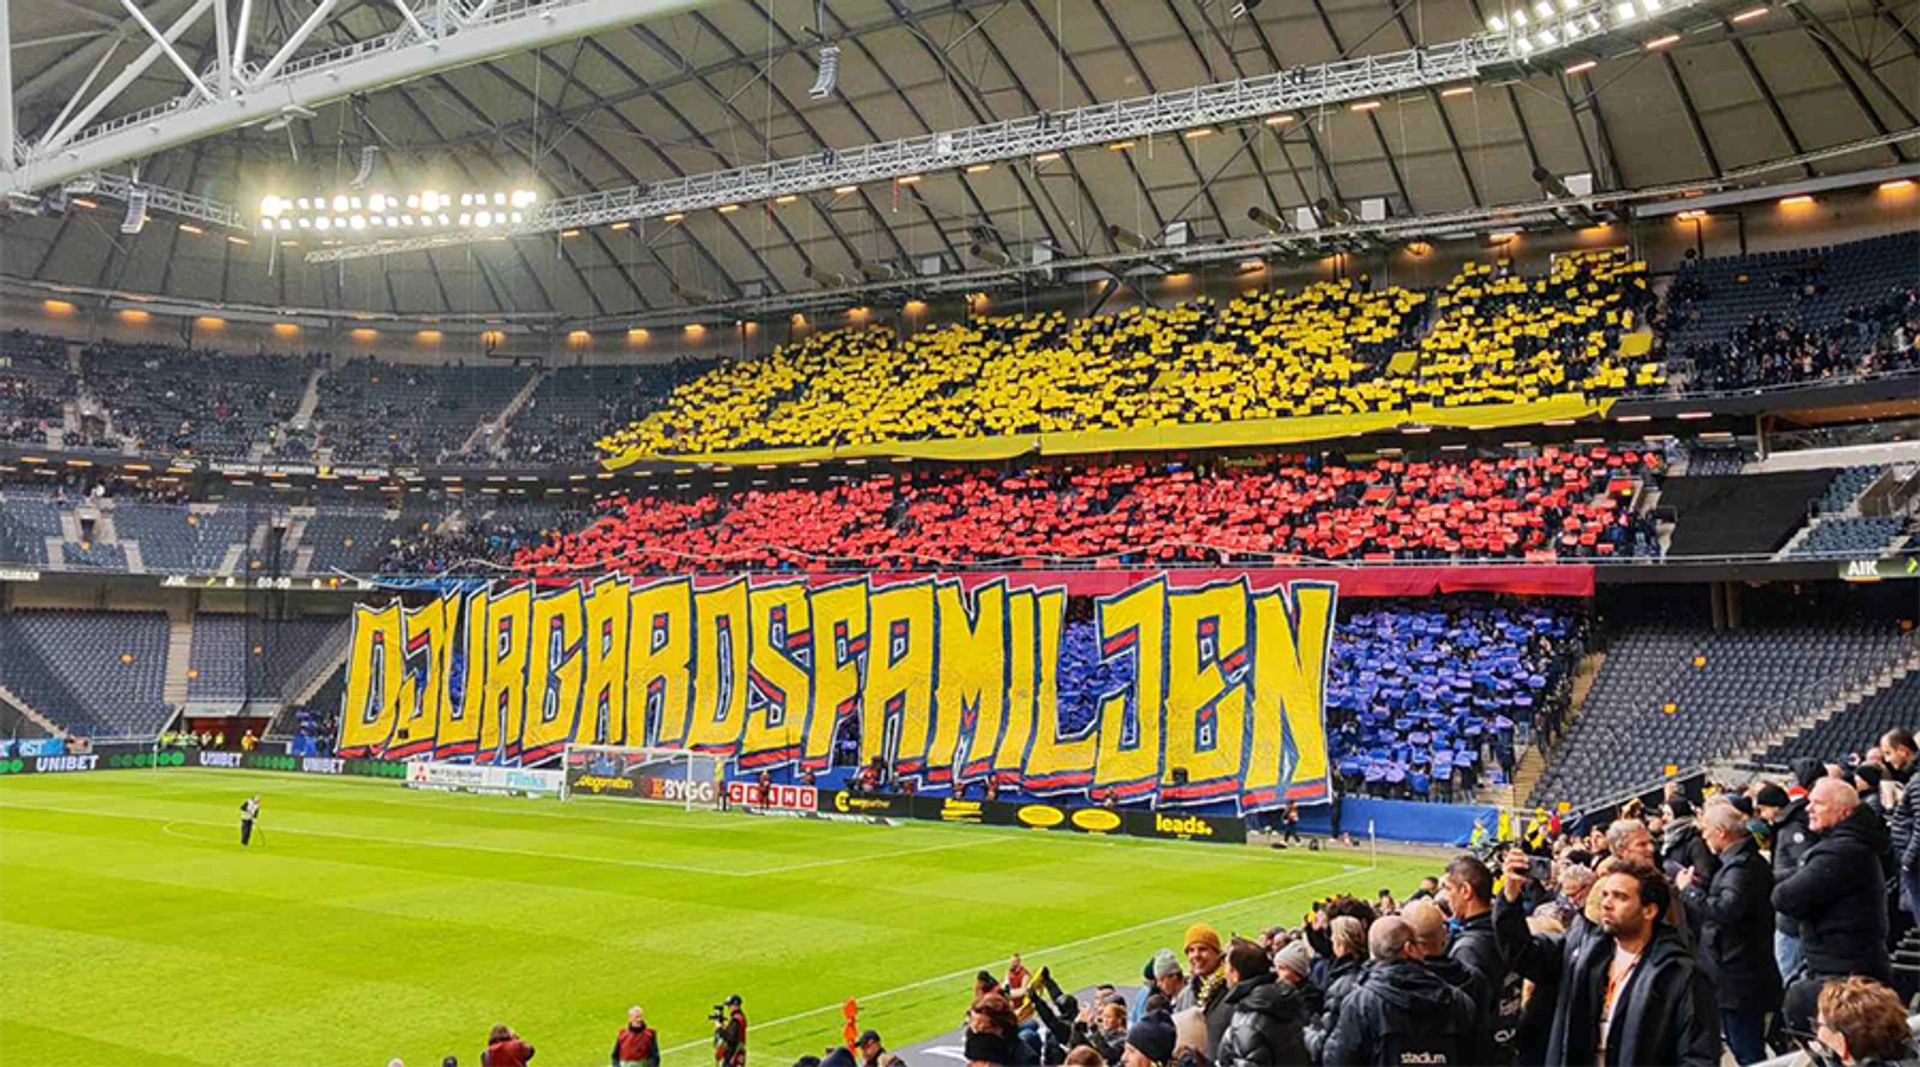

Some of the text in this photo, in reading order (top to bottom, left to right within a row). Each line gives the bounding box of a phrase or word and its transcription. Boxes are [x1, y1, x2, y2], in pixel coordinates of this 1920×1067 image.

[1848, 560, 1878, 575] AIK
[36, 755, 99, 772] UNIBET
[200, 751, 242, 767] UNIBET
[303, 757, 345, 773] UNIBET
[1401, 1052, 1446, 1064] stadium
